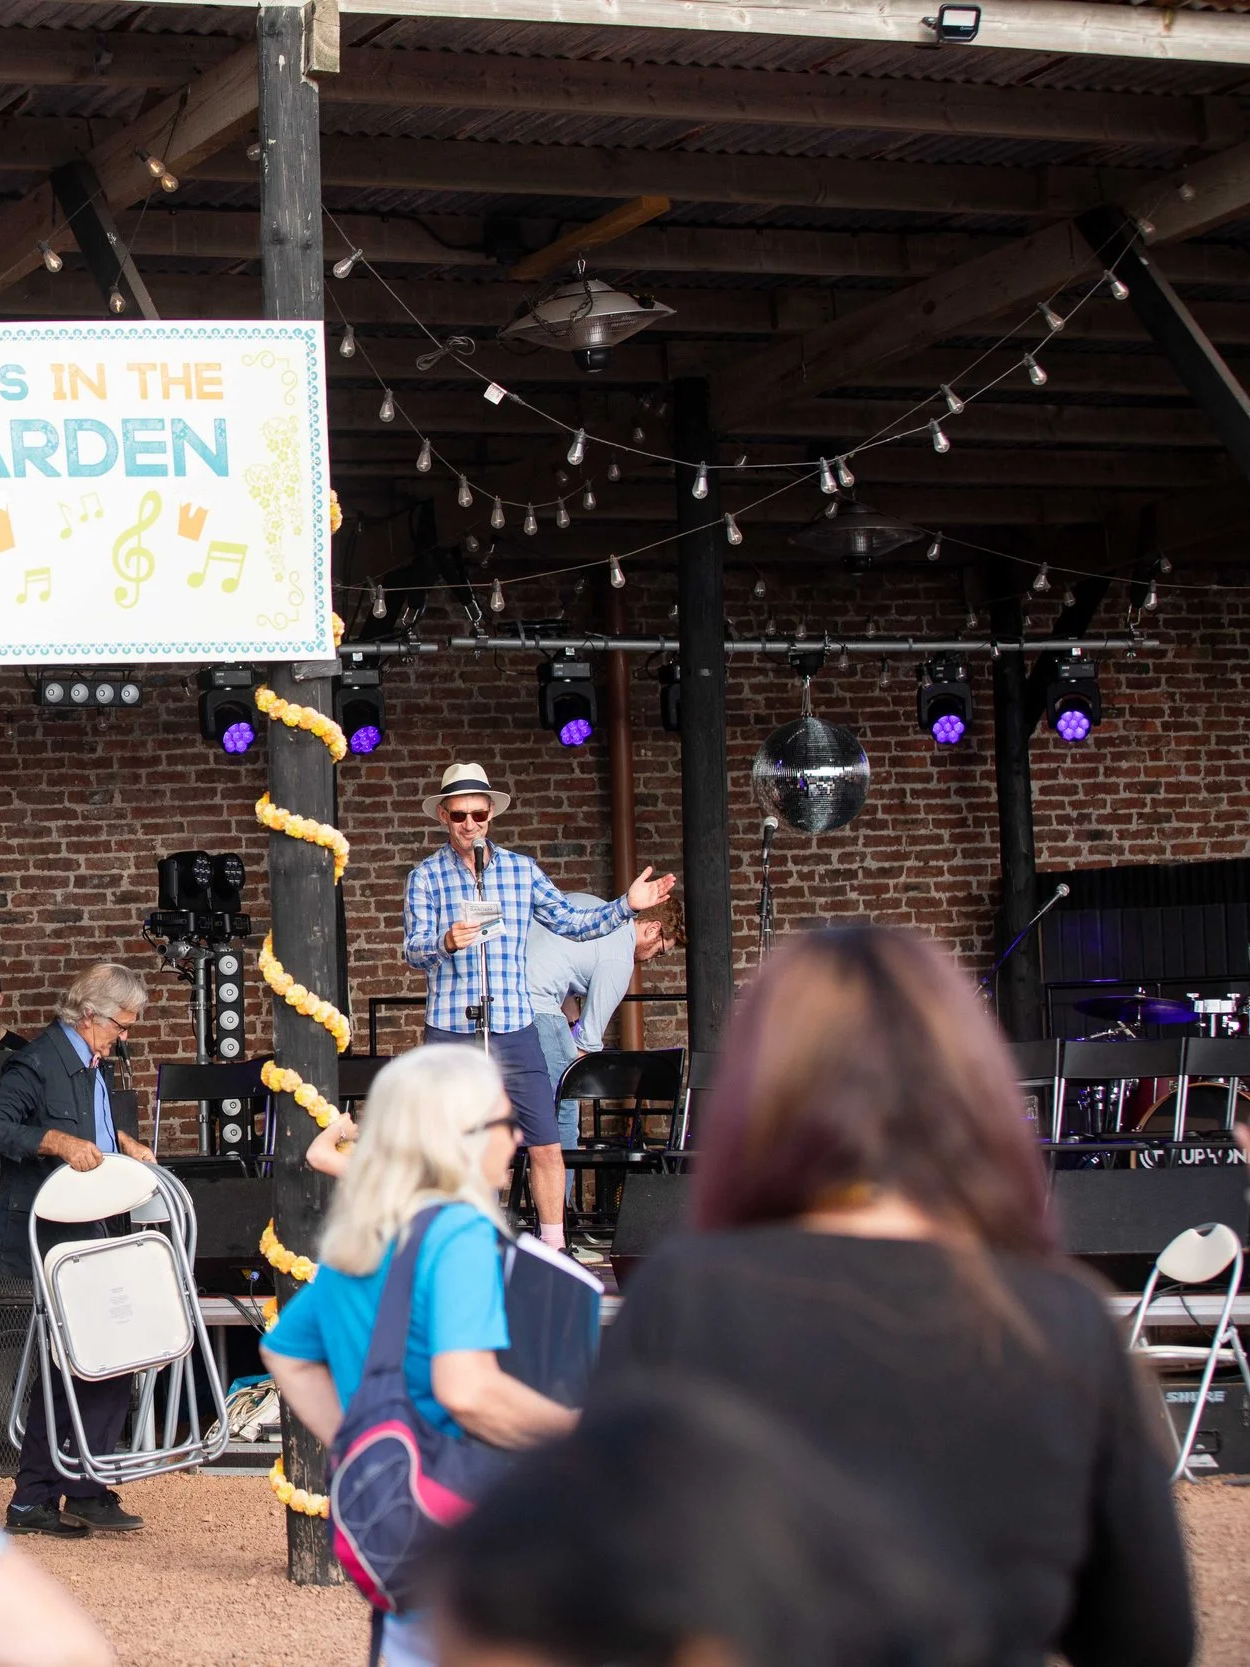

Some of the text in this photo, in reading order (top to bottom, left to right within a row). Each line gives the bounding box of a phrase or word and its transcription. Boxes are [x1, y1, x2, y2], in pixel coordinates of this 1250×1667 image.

[50, 363, 107, 401] IN
[126, 362, 224, 400] THE
[1165, 1390, 1226, 1403] SHURE
